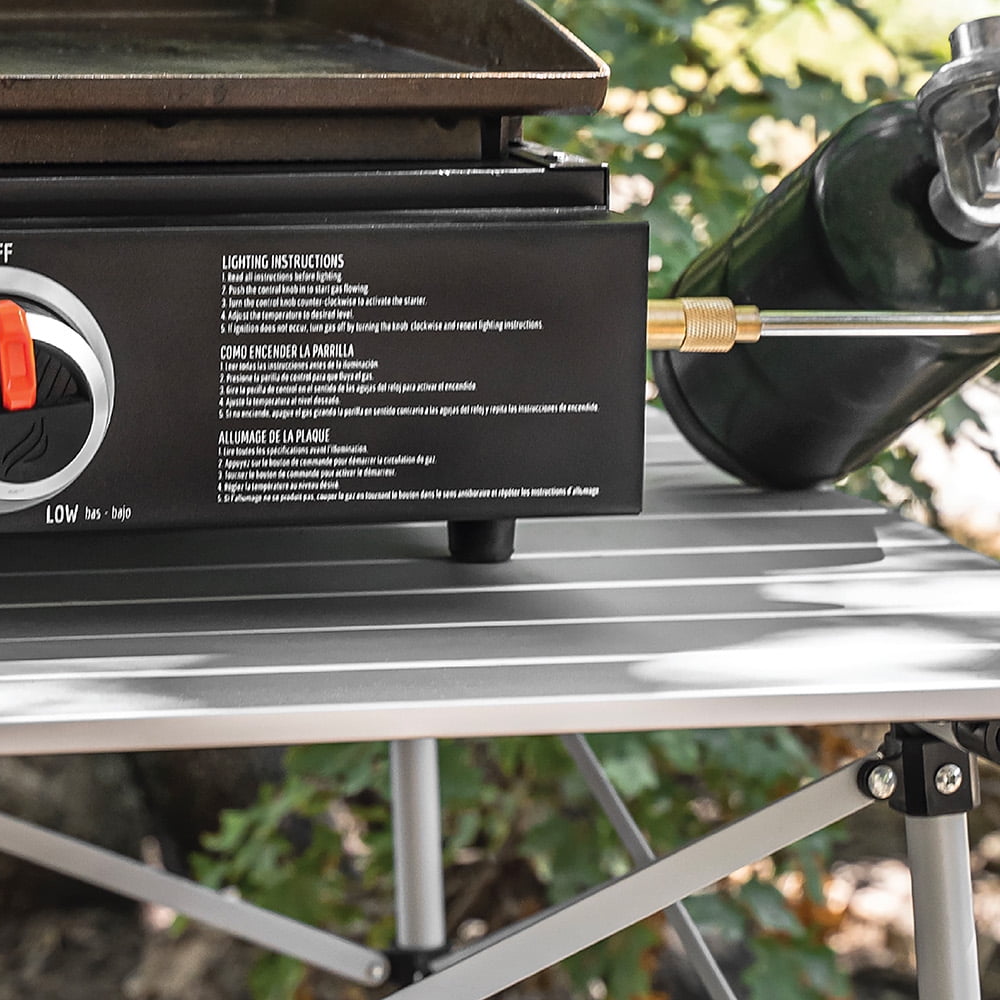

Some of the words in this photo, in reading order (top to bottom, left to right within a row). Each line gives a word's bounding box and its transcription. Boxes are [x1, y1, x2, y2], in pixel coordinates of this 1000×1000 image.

[222, 254, 269, 269] LIGHTING
[271, 253, 344, 268] INSTRUCTIONS
[220, 344, 247, 359] COMO
[250, 344, 298, 359] ENCENDER
[300, 343, 311, 358] LA
[313, 343, 354, 358] PARRILLA
[218, 429, 267, 444] ALLUMAGE
[269, 429, 281, 443] DE
[283, 429, 294, 443] LA
[296, 428, 330, 443] PLAQUE
[46, 504, 78, 524] LOW
[85, 506, 101, 520] bas
[111, 505, 132, 522] bajo
